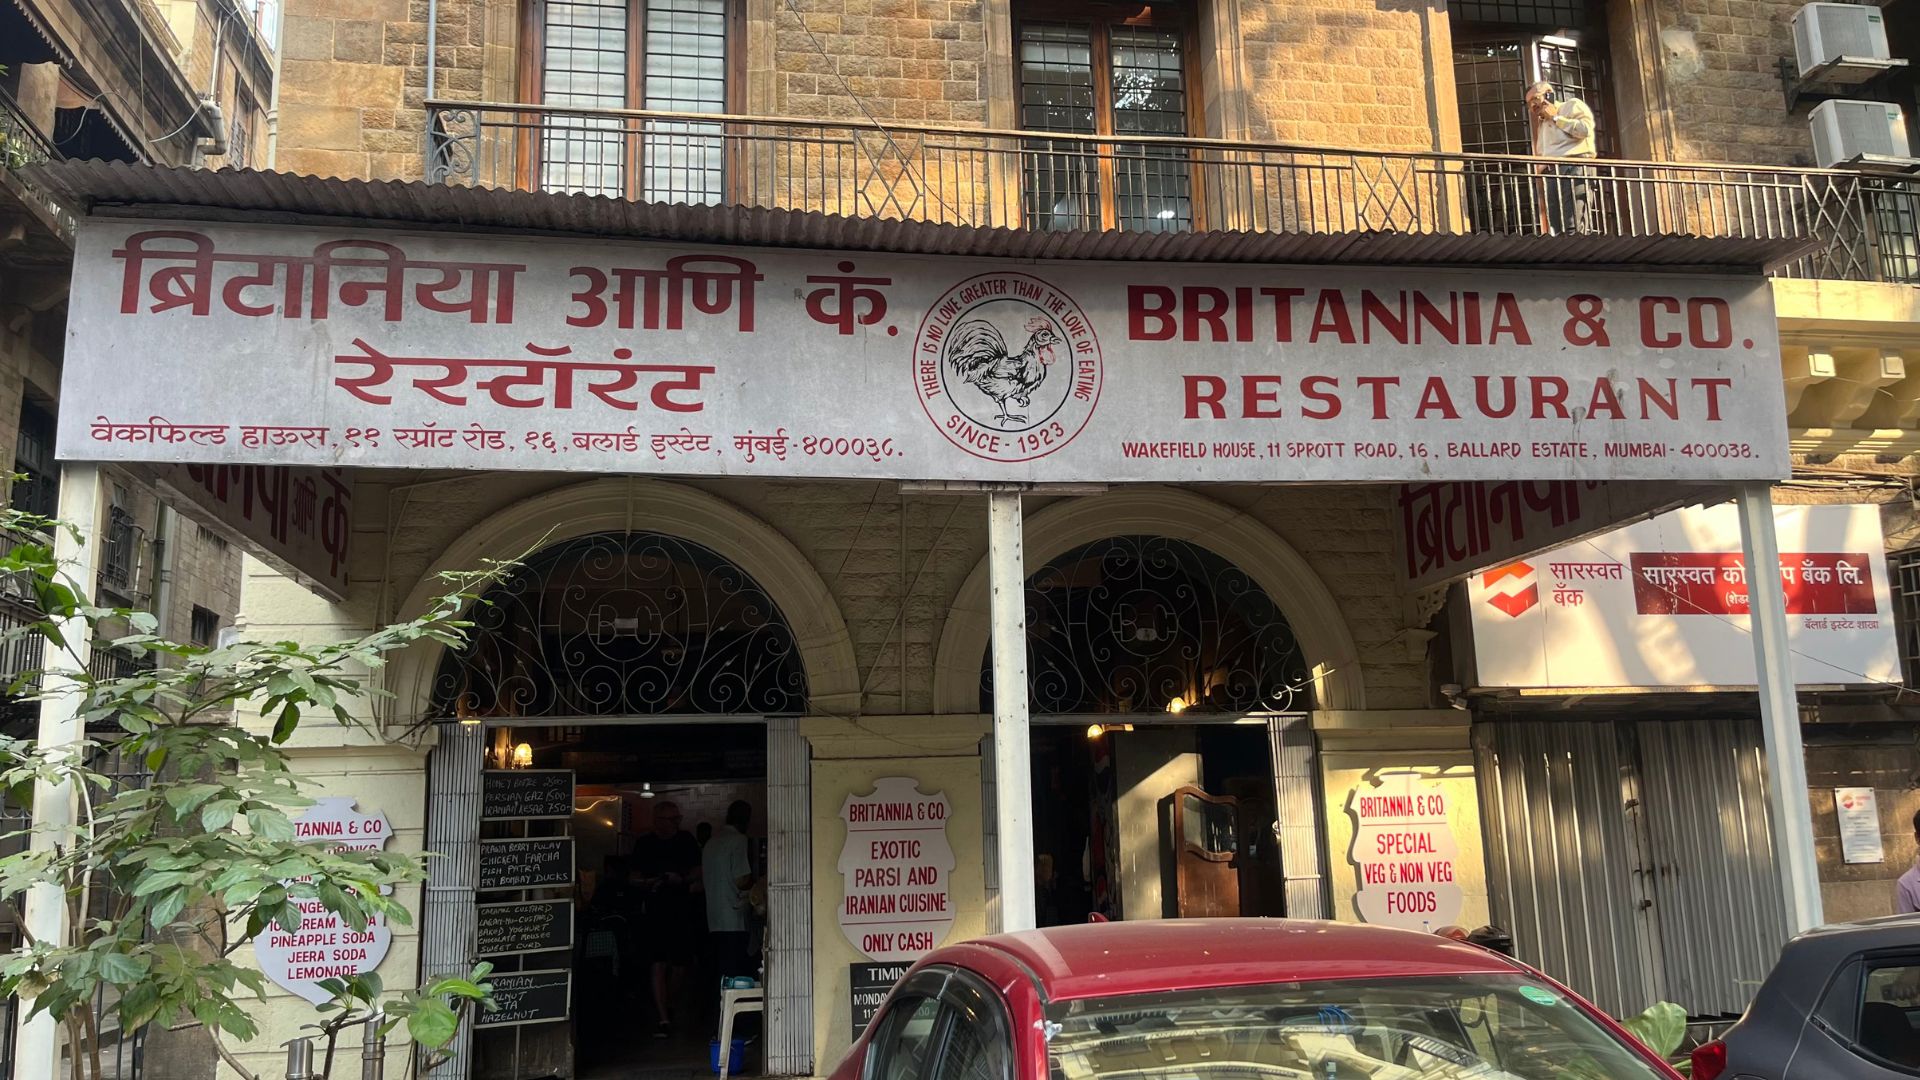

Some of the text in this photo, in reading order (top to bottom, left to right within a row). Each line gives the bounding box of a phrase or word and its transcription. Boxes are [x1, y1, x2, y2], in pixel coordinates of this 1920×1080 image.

[112, 230, 899, 337] ब्रिटानिया आणि कं.
[1127, 285, 1755, 350] BRITANNIA & CO.
[920, 279, 1095, 402] THERE IS NO LOVE GREATER THAN THE LOVE OF EATING
[334, 337, 716, 413] रेस्टॉरंट
[1182, 374, 1732, 422] RESTAURANT
[90, 416, 230, 445] वेकफिल्ड
[240, 426, 338, 449] हाऊस,
[392, 421, 458, 450] स्प्रॉट
[462, 422, 514, 452] रोड,
[571, 425, 640, 452] बलार्ड
[650, 427, 722, 460] इस्टेट,
[1121, 442, 1207, 458] WAKEFIELD
[1213, 442, 1264, 460] HOUSE,
[1267, 442, 1282, 458] 11
[1286, 442, 1345, 458] SPROTT
[1354, 442, 1404, 460] ROAD,
[1408, 442, 1439, 459] 16,
[1447, 442, 1522, 460] BALLARD
[1531, 442, 1597, 460] ESTATE,
[1549, 562, 1623, 581] सारस्वत
[1641, 566, 1716, 586] सारस्वत
[1800, 559, 1831, 585] बँक
[1835, 560, 1864, 585] लि.
[1552, 583, 1584, 607] बँक
[1829, 617, 1855, 632] इस्टेट
[1857, 620, 1879, 630] शाखा
[485, 791, 524, 803] PERSIAN
[524, 791, 544, 802] GAZ
[1360, 795, 1446, 818] BRITANNIA & CO.
[849, 802, 946, 822] BRITANNIA & CO.
[294, 819, 382, 836] TANNIA & CO
[533, 841, 562, 851] PULAV
[871, 840, 921, 860] EXOTIC
[1377, 832, 1437, 854] SPECIAL
[480, 851, 560, 866] CHICKEN FARCHA
[481, 863, 541, 877] FISH PATRA
[855, 866, 938, 887] PARSI AND
[1364, 861, 1453, 884] VEG & NON VEG
[481, 872, 569, 888] FRY BOMBAY DUCKS
[514, 904, 553, 914] CUSTARD
[846, 893, 946, 915] IRANIAN CUISINE
[1387, 891, 1436, 914] FOODS
[270, 931, 376, 948] PINEAPPLE SODA
[478, 923, 550, 938] BAKED YOGHURT
[478, 934, 517, 945] CHOCOLATE
[480, 941, 542, 953] SWEET CURD
[863, 932, 933, 953] ONLY CASH
[287, 948, 367, 963] JEERA SODA
[287, 964, 358, 980] LEMONADE
[493, 991, 528, 1002] ALNUT
[481, 1008, 540, 1024] HAZELNUT
